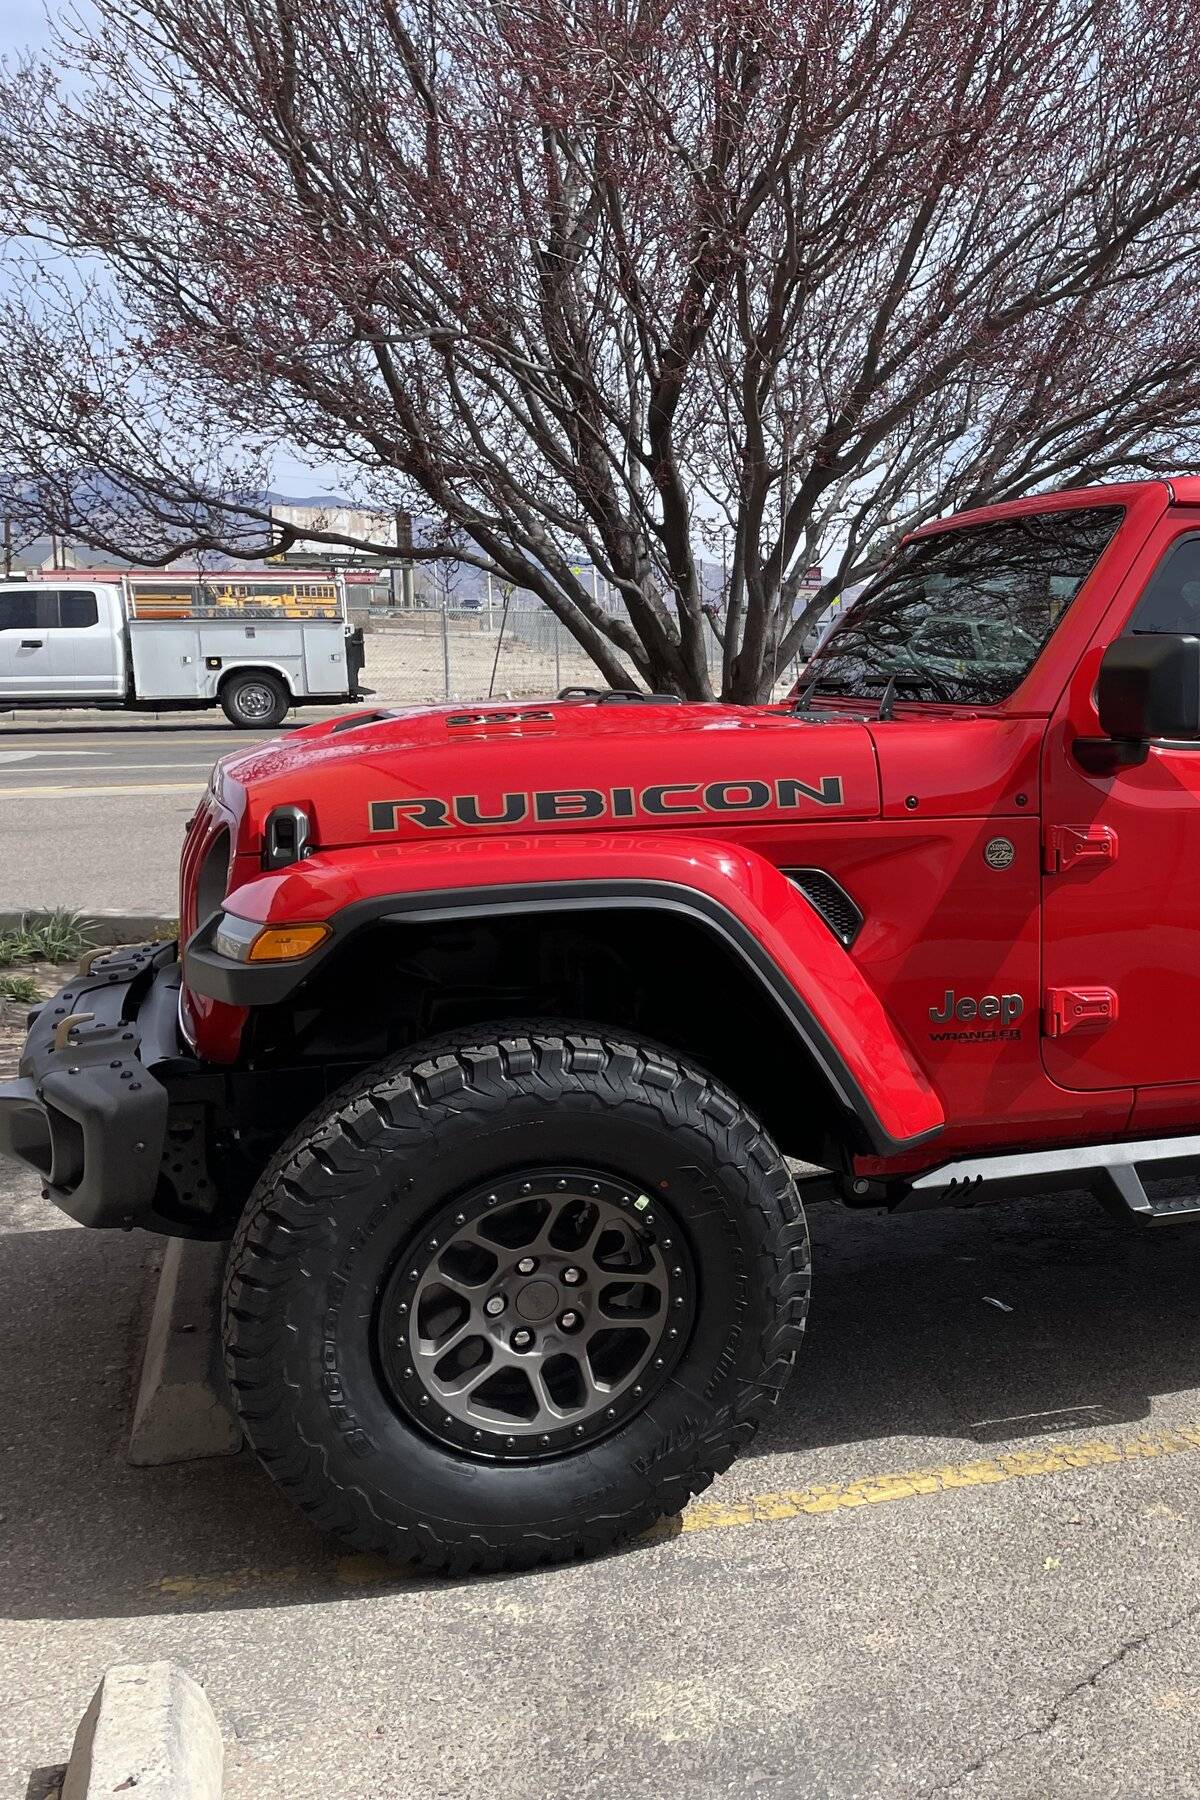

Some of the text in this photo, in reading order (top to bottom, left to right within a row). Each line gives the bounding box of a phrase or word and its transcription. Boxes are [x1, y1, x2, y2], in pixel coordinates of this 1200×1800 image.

[368, 776, 845, 833] RUBICON
[929, 990, 1024, 1025] Jeep
[928, 1028, 1022, 1041] WRANGLER
